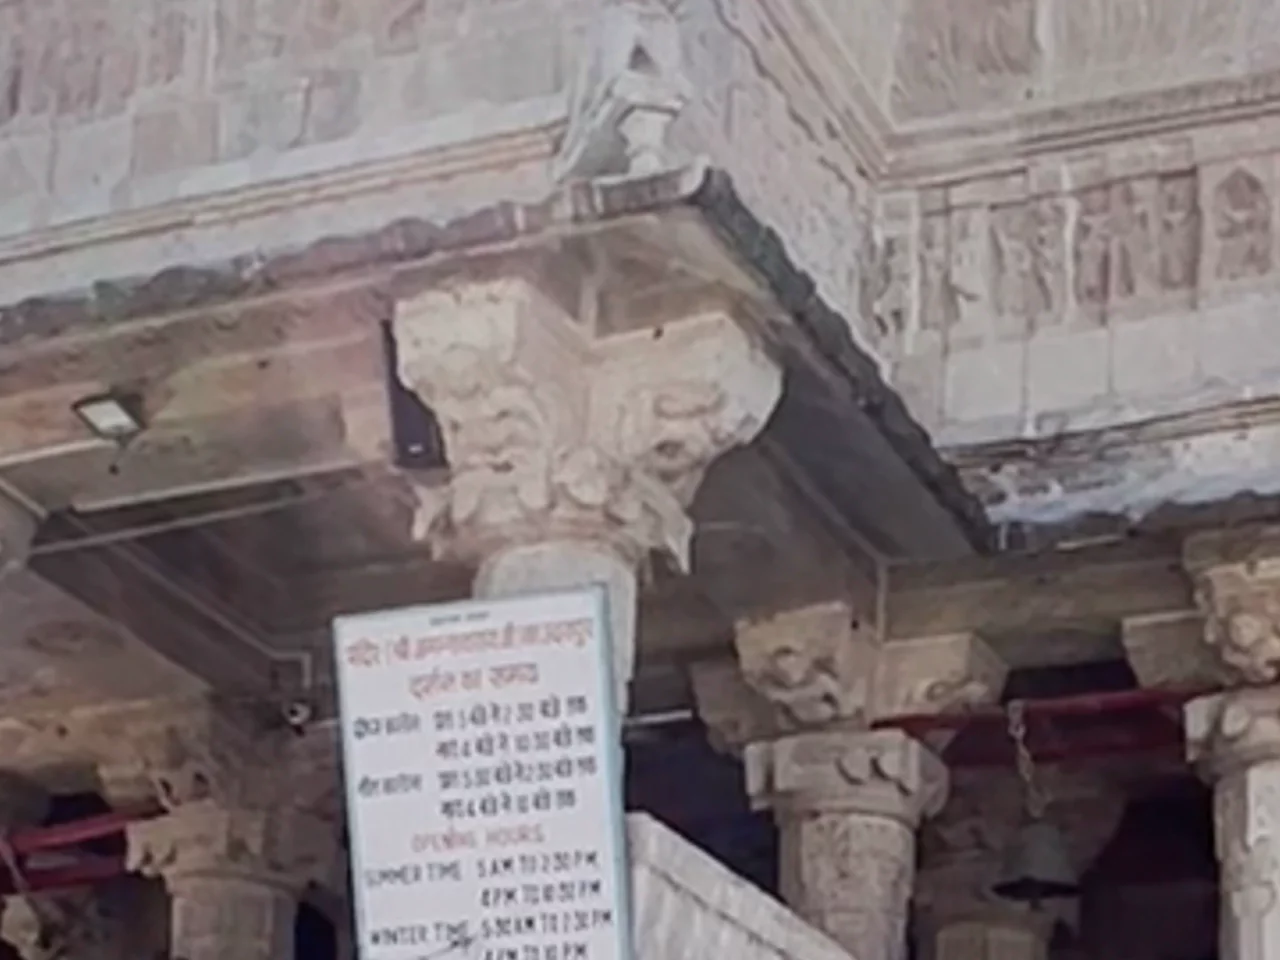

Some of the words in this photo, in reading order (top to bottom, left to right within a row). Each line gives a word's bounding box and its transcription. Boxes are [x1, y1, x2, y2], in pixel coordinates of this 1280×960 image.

[489, 662, 538, 688] समय
[411, 830, 477, 853] OPENING
[486, 823, 544, 848] HOURS
[366, 863, 421, 887] SUMMER
[426, 860, 462, 882] TIME
[371, 925, 427, 946] WINTER
[433, 919, 469, 942] TIME
